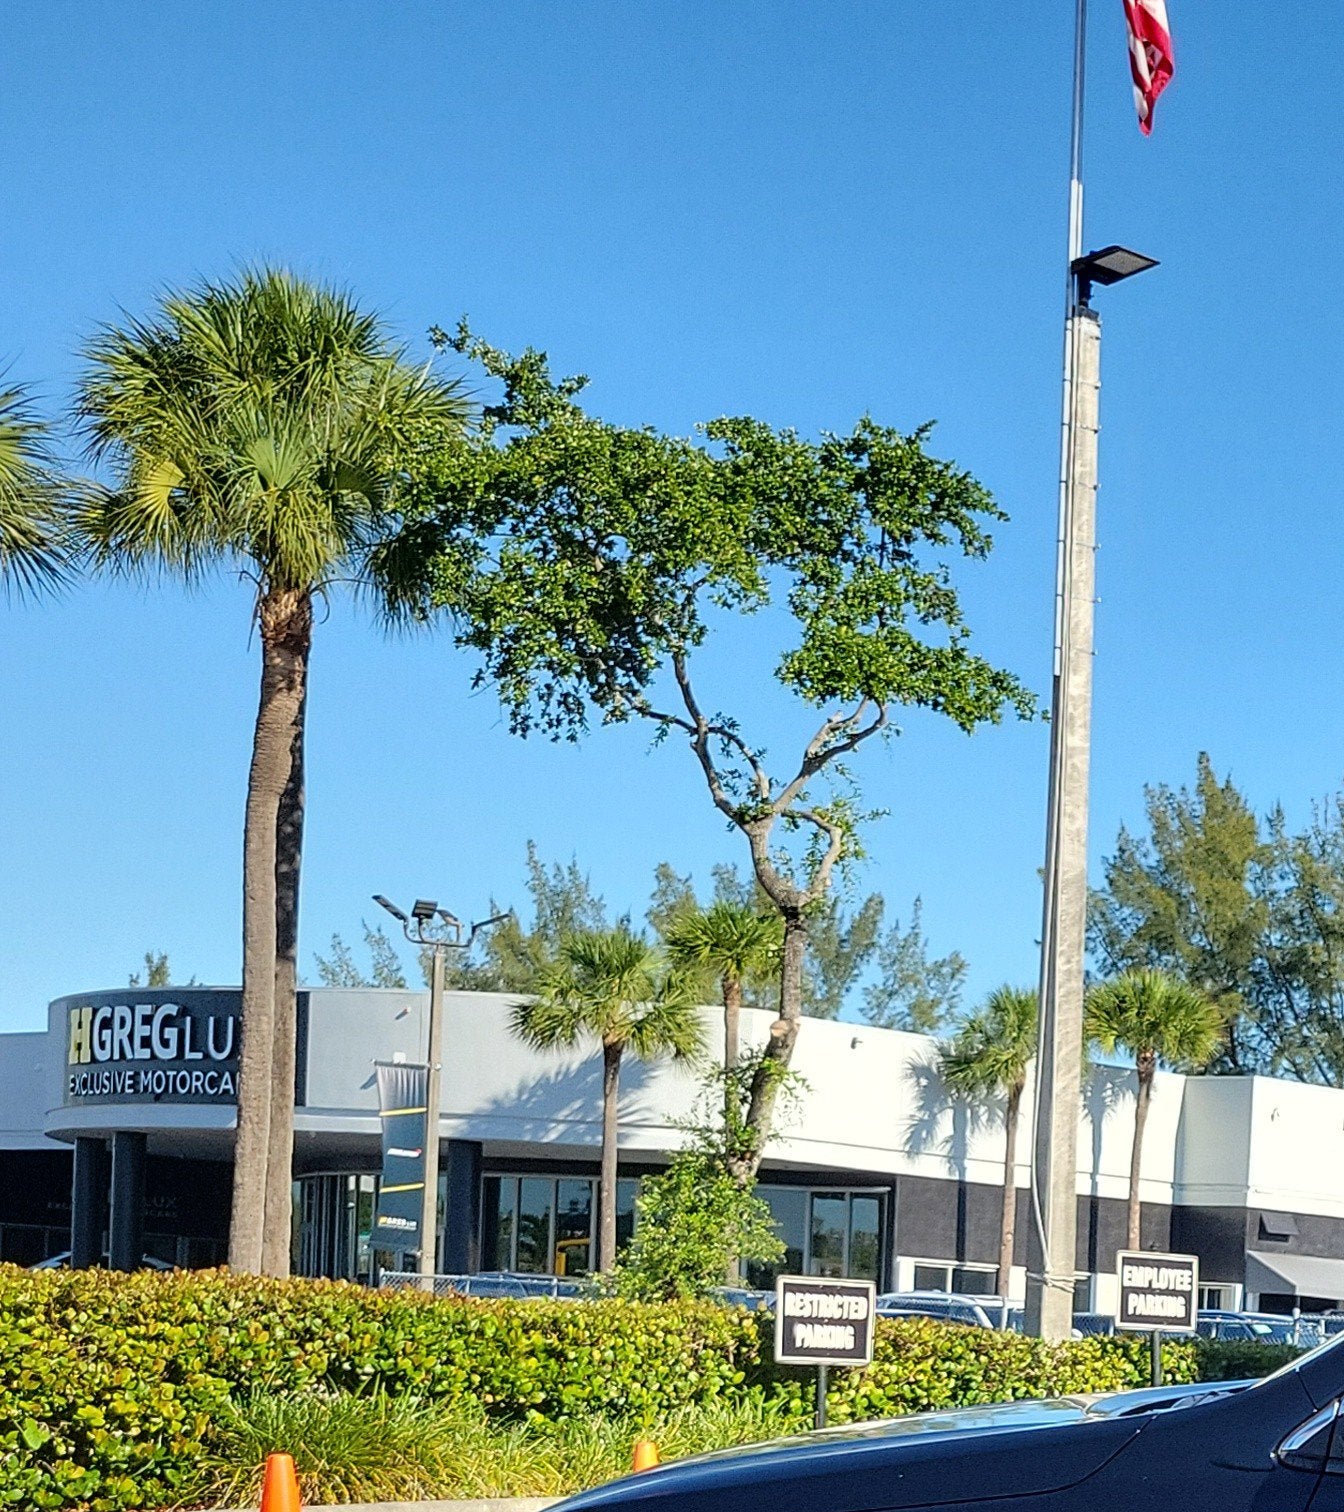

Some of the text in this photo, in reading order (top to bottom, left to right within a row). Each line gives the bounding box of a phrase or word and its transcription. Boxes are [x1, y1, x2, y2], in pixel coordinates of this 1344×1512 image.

[185, 1015, 242, 1061] LU
[69, 1070, 241, 1096] EXCLUSIVE MOTORCA
[1122, 1264, 1192, 1291] EMPLOYEE
[784, 1292, 868, 1320] RESTRICTED
[1127, 1293, 1186, 1318] PARKING
[793, 1323, 855, 1350] PARKING
